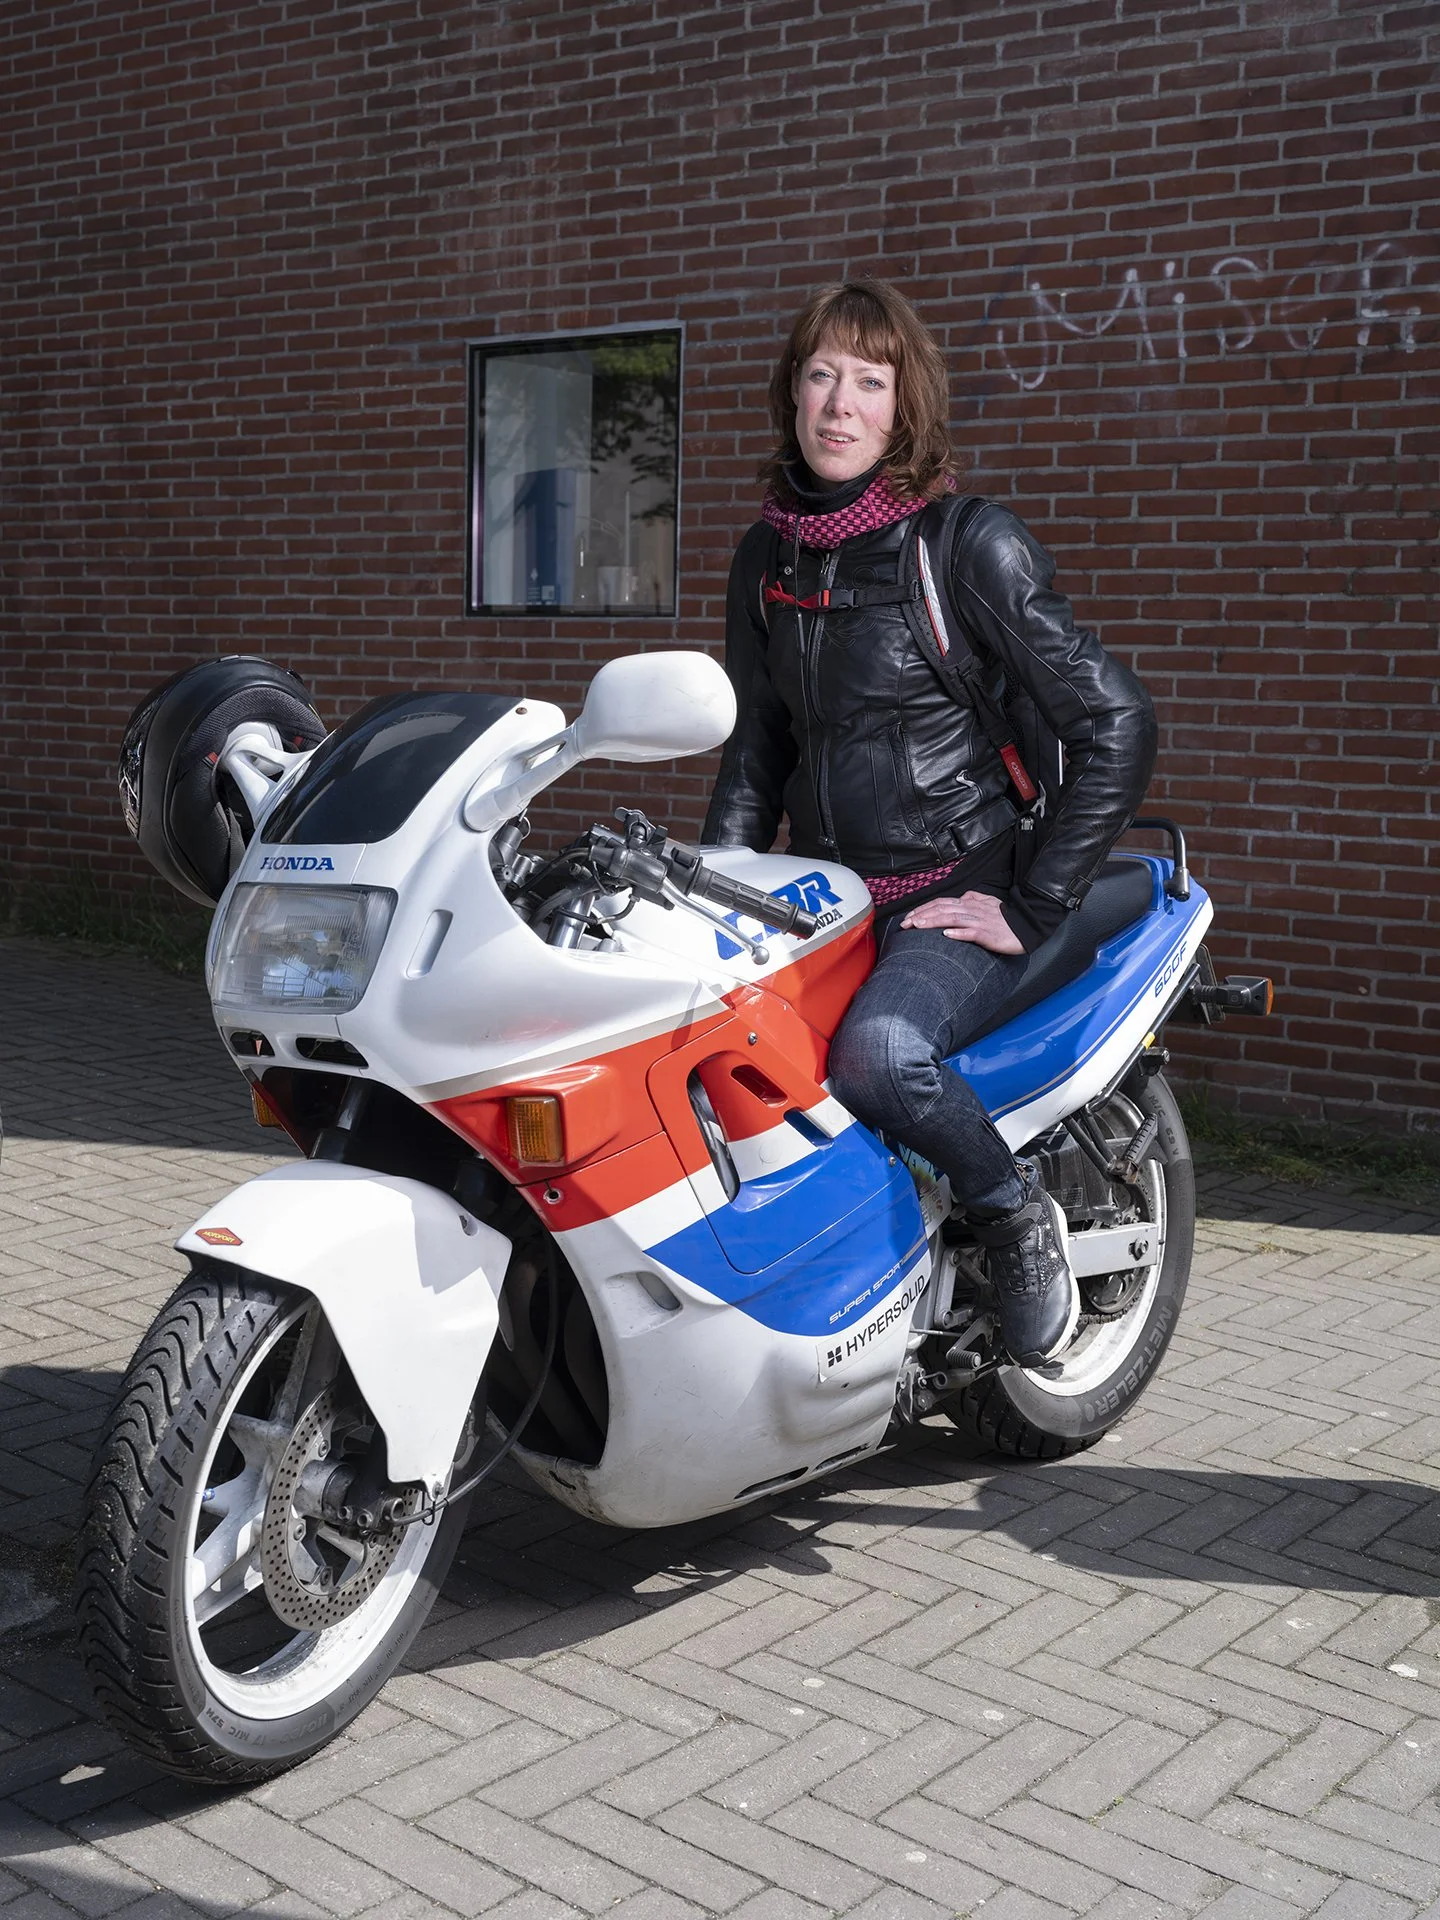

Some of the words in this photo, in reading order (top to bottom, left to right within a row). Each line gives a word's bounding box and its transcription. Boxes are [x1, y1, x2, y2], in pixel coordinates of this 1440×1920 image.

[260, 857, 334, 870] HONDA
[1155, 941, 1187, 997] 600F
[829, 1289, 871, 1324] SUPER
[846, 1275, 925, 1356] HYPERSOLID
[1097, 1306, 1173, 1417] METZELER
